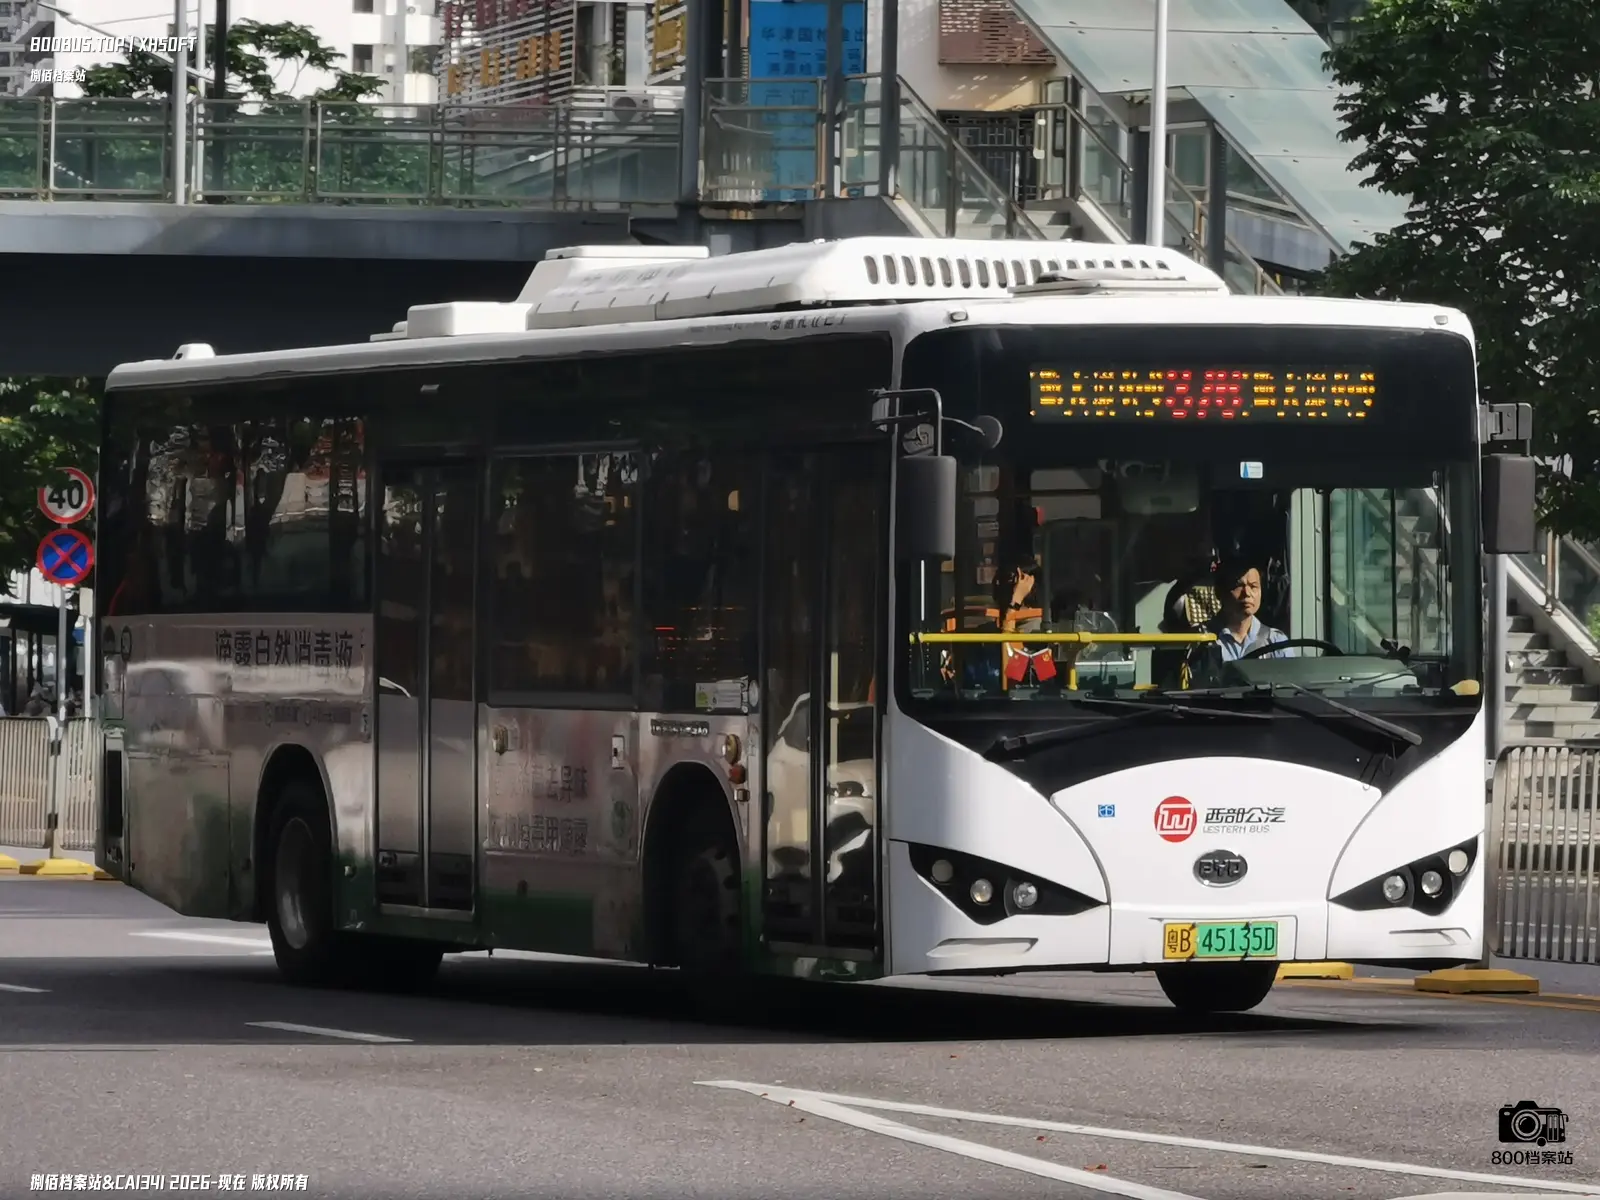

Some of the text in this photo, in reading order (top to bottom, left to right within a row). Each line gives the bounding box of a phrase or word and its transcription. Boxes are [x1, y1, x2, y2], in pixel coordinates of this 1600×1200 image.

[47, 480, 84, 509] 40
[1249, 825, 1270, 833] BUS
[1199, 859, 1241, 876] BYD
[1202, 927, 1275, 952] 45135D
